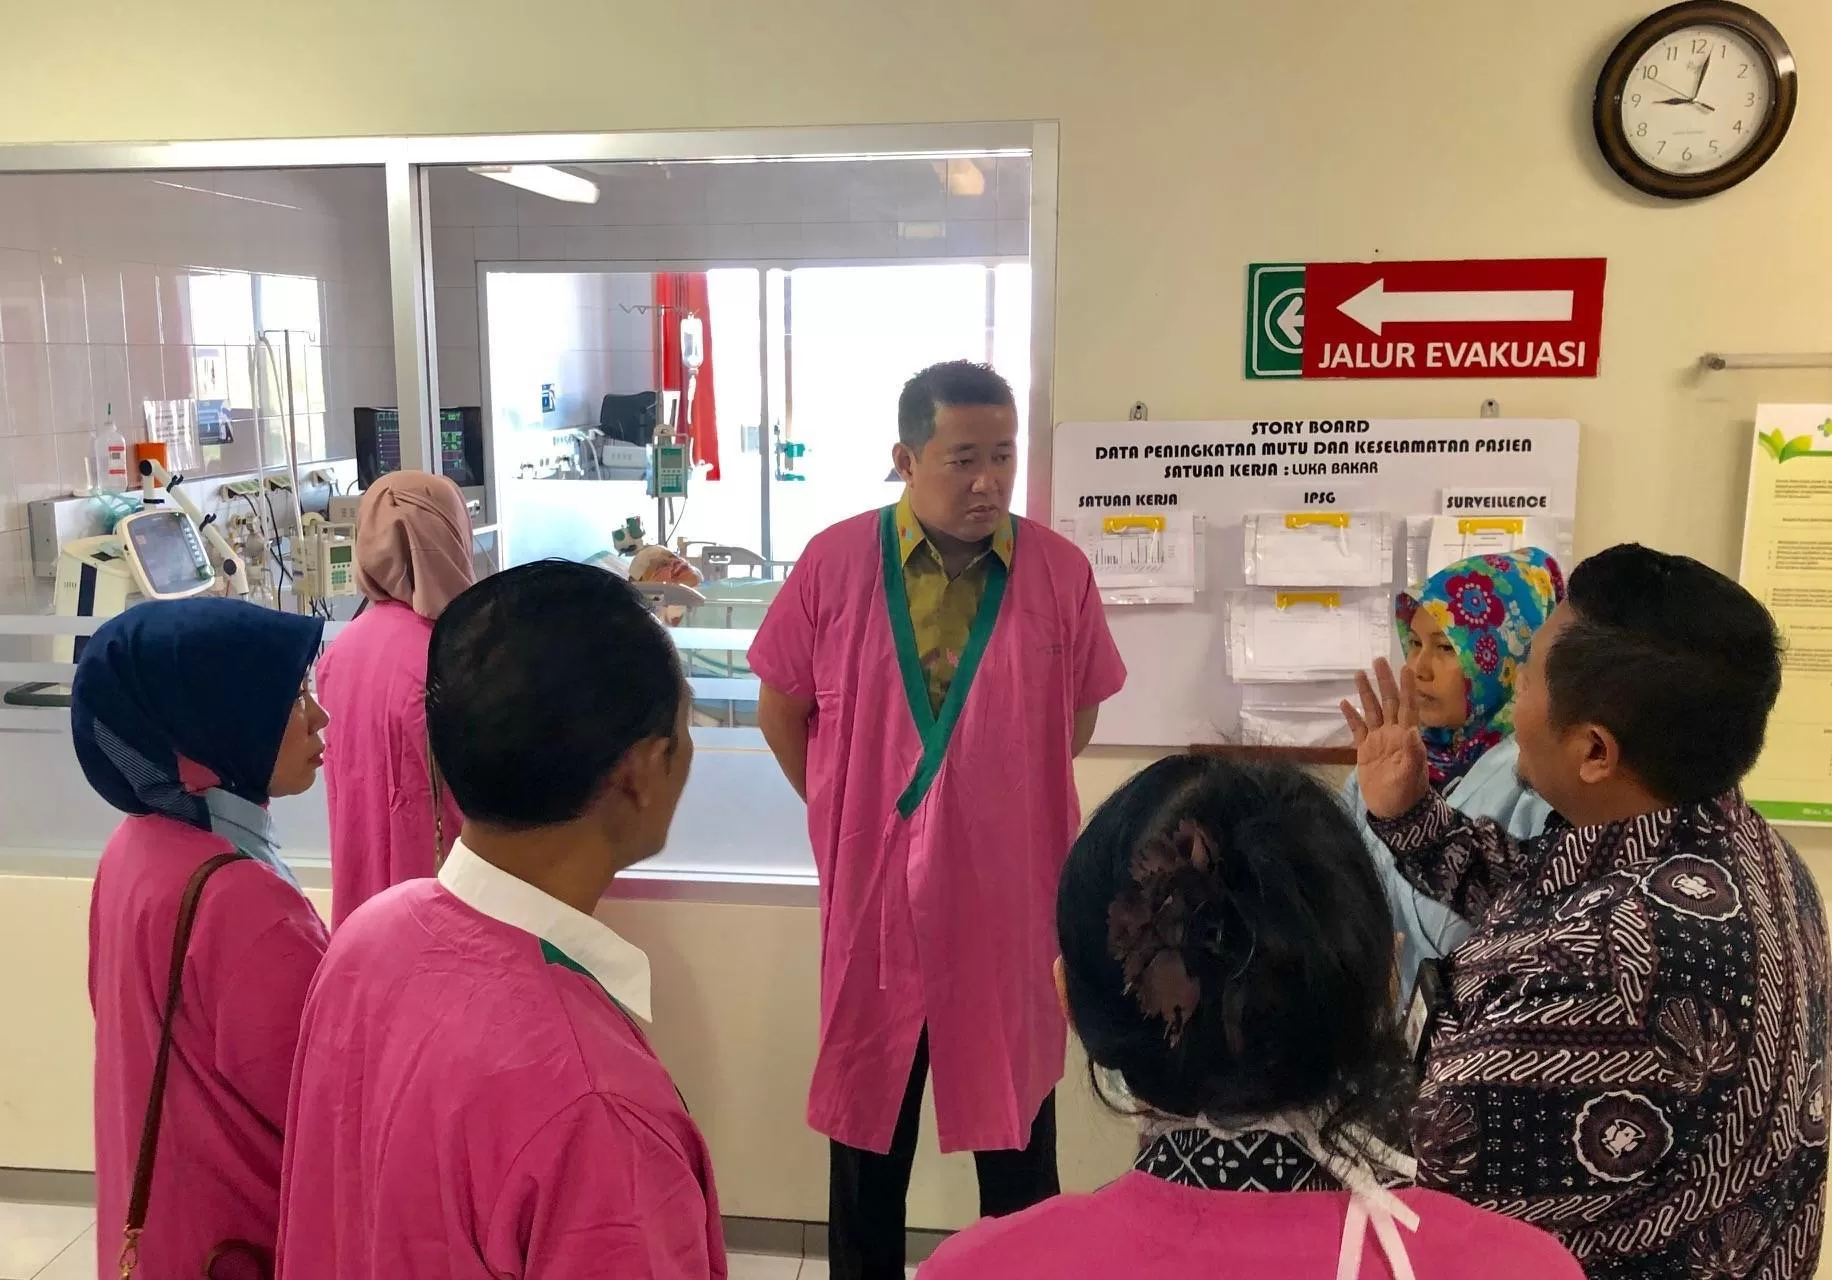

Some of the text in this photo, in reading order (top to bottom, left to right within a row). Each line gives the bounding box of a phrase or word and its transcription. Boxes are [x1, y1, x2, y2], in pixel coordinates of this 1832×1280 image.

[1666, 46, 1678, 61] 11
[1691, 39, 1708, 55] 12
[1720, 45, 1727, 59] 1
[1642, 65, 1658, 80] 10
[1736, 64, 1748, 79] 2
[1631, 94, 1641, 109] 9
[1744, 92, 1755, 108] 3
[1636, 122, 1648, 137] 8
[1732, 120, 1742, 134] 4
[1656, 140, 1666, 156] 7
[1681, 147, 1692, 161] 6
[1708, 139, 1719, 154] 5
[1319, 341, 1585, 368] JALUR EVAKUASI
[1252, 420, 1369, 435] STORY BOARD
[1096, 439, 1531, 459] DATA PENINGKATAN MUTU DAN KESELAMATAN PASIEN
[1165, 465, 1223, 478] SATUAN
[1230, 463, 1277, 476] KERJA
[1332, 462, 1378, 474] BAKAR
[1079, 494, 1177, 507] SATUAN KERJA
[1305, 492, 1335, 503] IPSG
[1447, 496, 1546, 508] SURVEILLENCE
